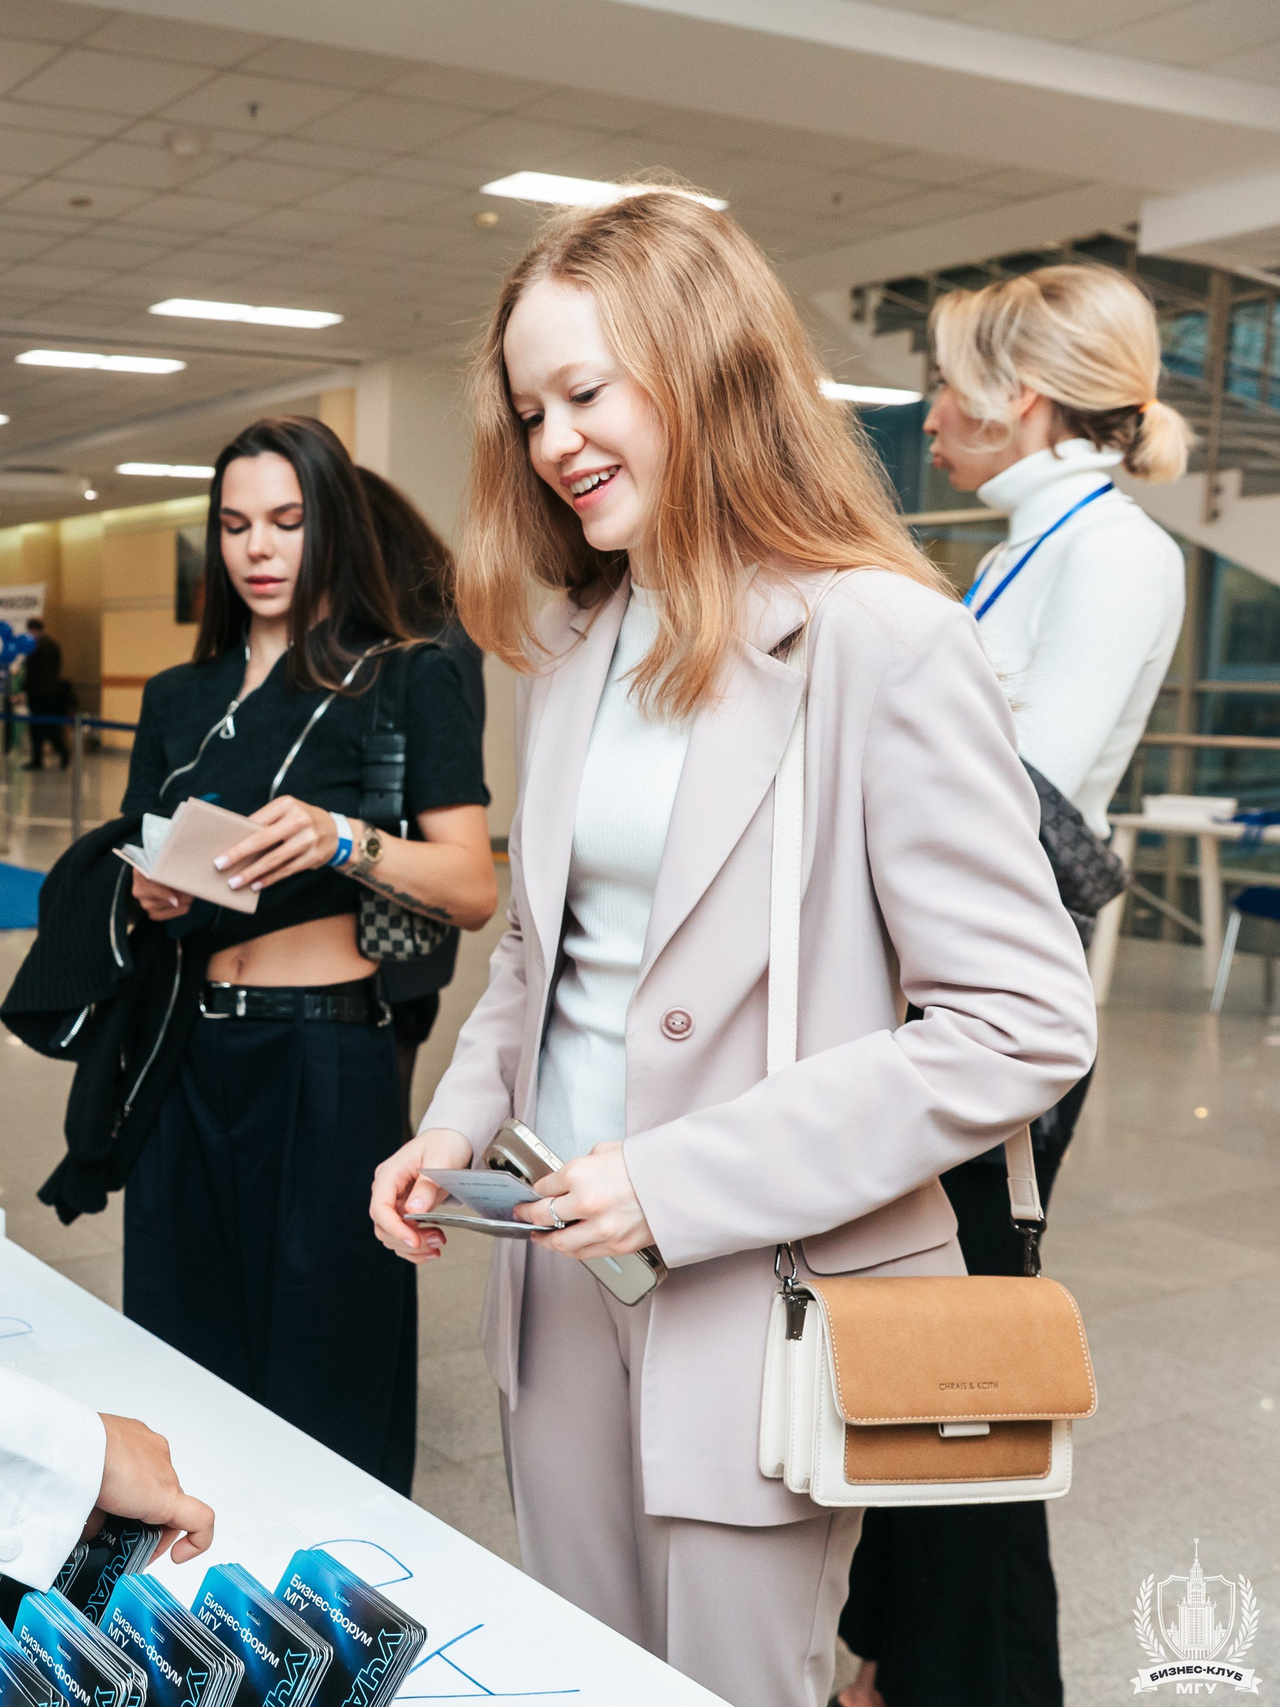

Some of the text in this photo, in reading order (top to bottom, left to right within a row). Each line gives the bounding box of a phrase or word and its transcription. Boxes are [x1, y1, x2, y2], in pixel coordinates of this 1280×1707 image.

[108, 1622, 129, 1648] МГУ
[198, 1606, 222, 1632] МГУ
[203, 1592, 280, 1668] Бизнес-форум
[283, 1587, 310, 1612] МГУ
[290, 1573, 373, 1647] Бизнес-форум
[20, 1625, 91, 1706] Бизнес-форум
[112, 1607, 183, 1687] Бизнес-форум
